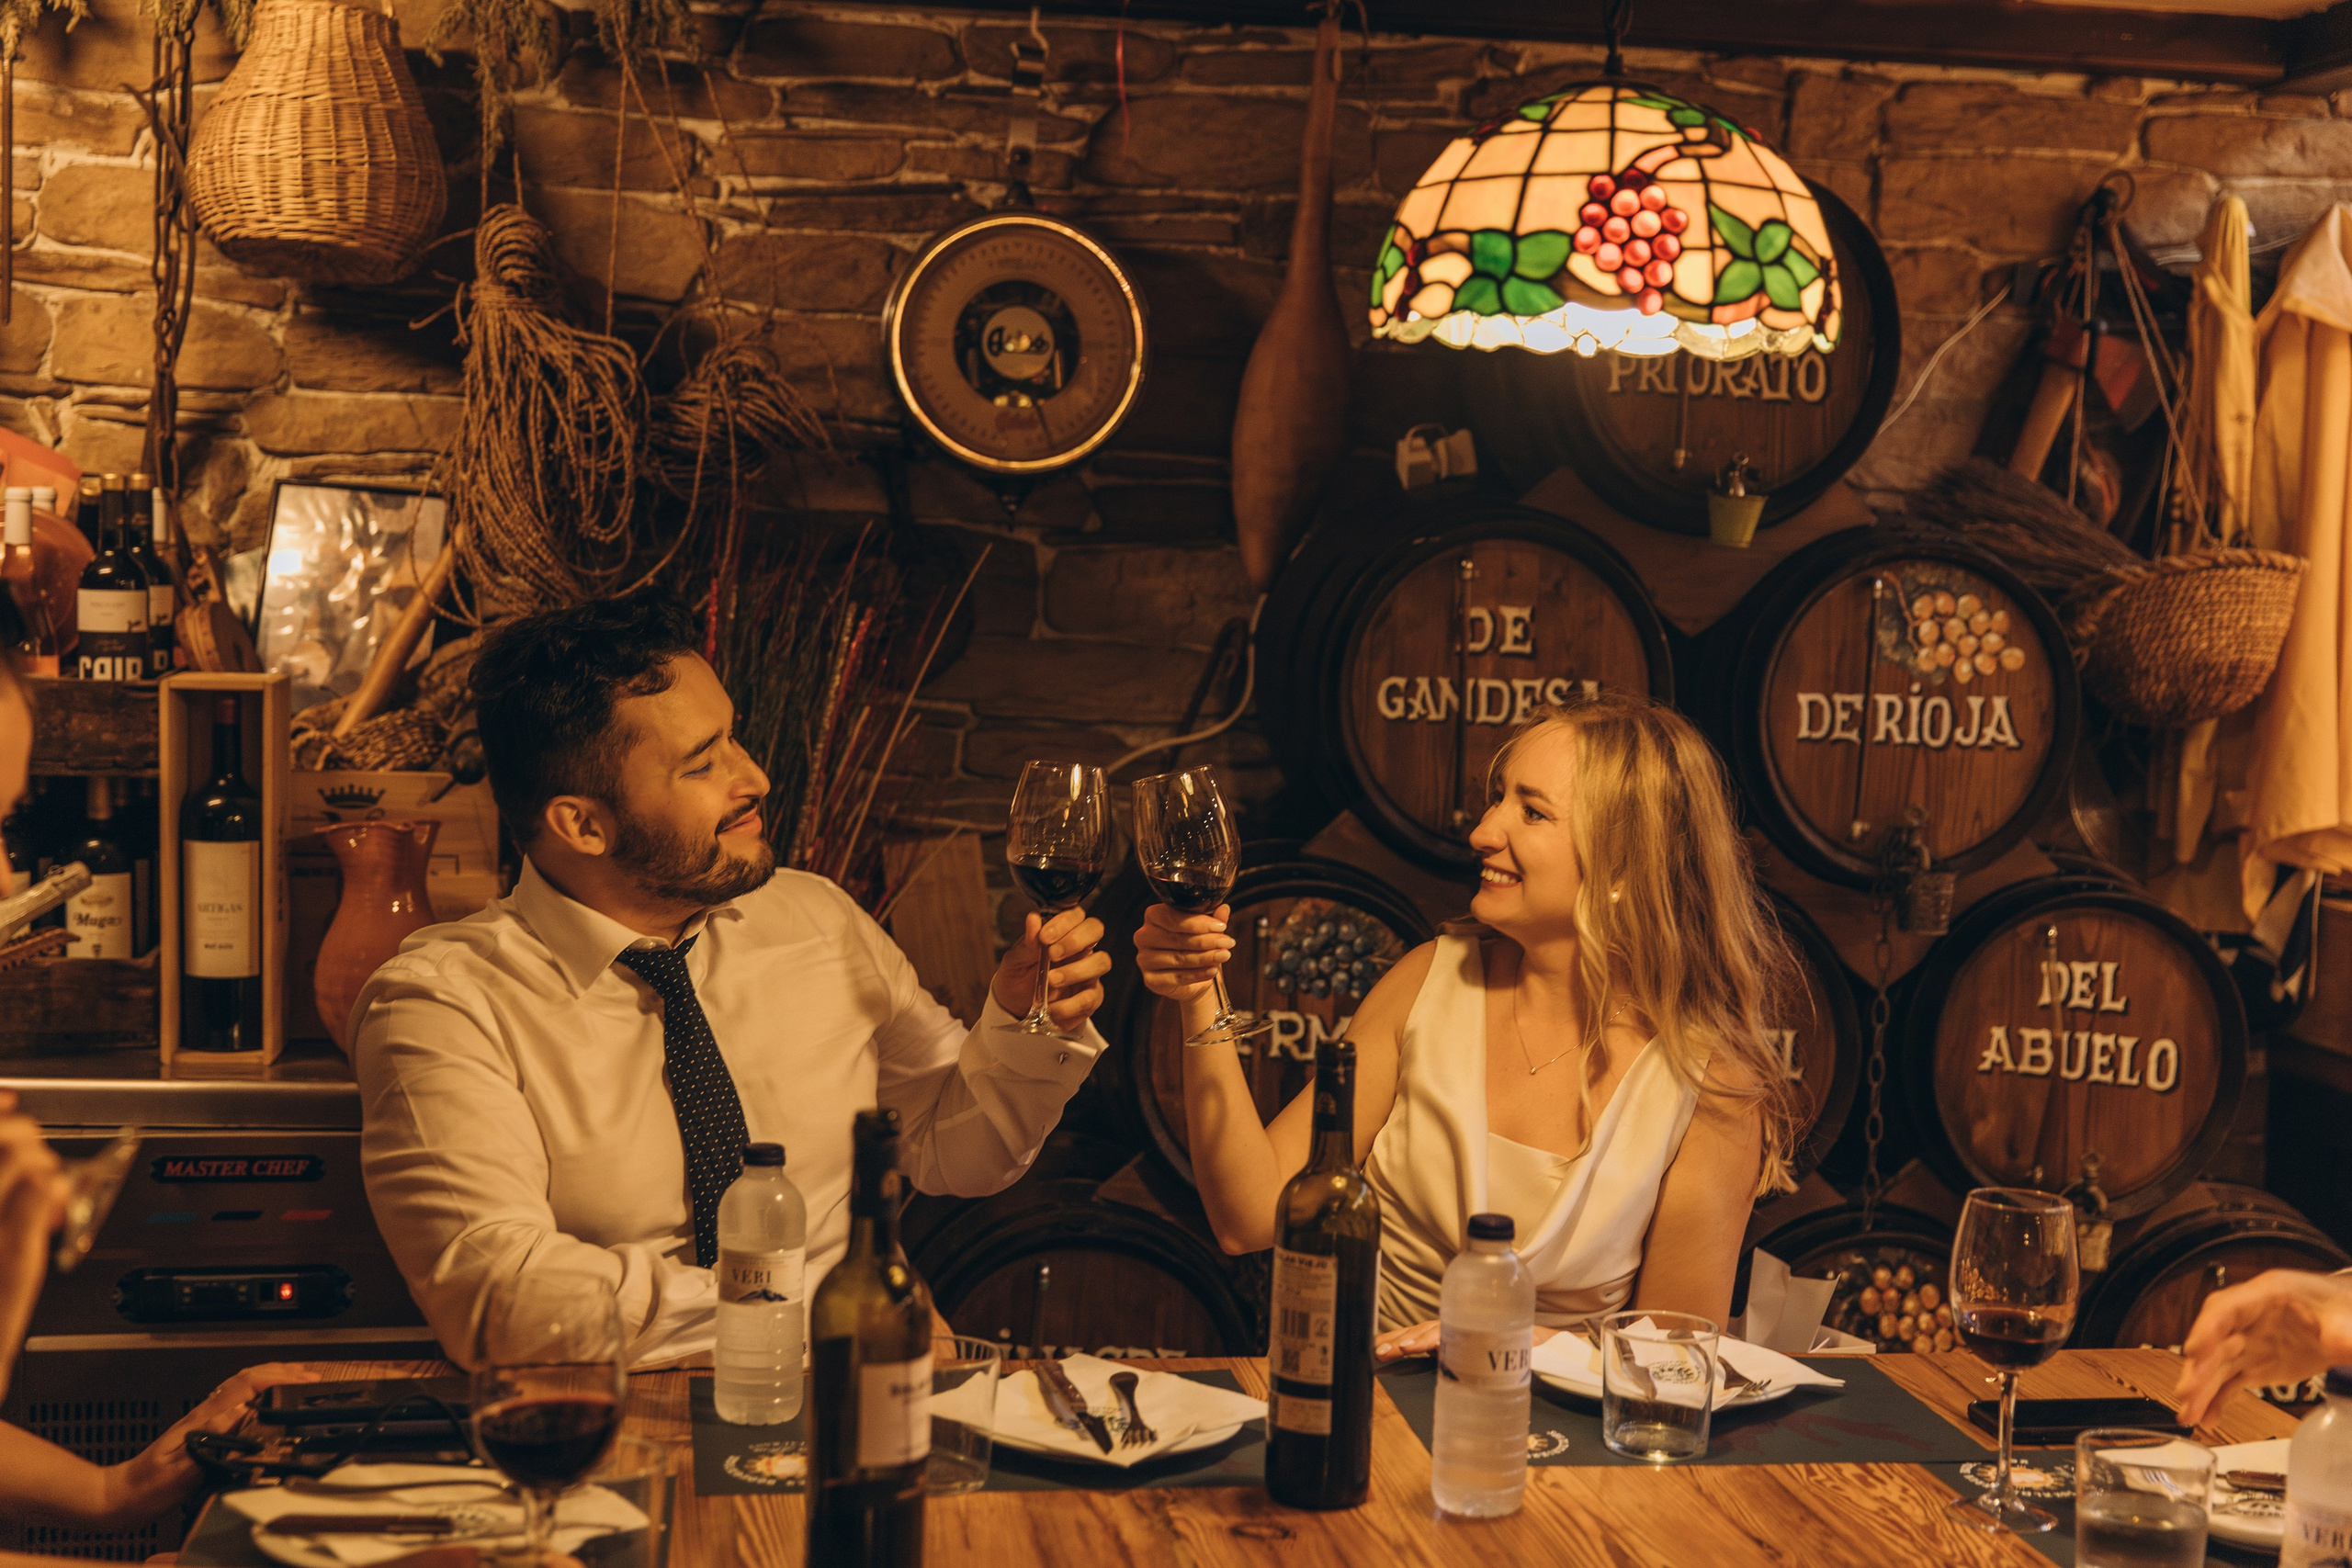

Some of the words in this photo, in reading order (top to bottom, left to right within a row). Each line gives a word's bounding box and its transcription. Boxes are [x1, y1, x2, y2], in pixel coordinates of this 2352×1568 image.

[1609, 350, 1826, 402] PRIORATO
[1455, 605, 1534, 655] DE
[1797, 692, 1865, 742] DE
[2037, 960, 2128, 1012] DEL
[1977, 1025, 2178, 1091] ABUELO
[164, 1160, 248, 1177] MASTER
[252, 1159, 310, 1176] CHEF
